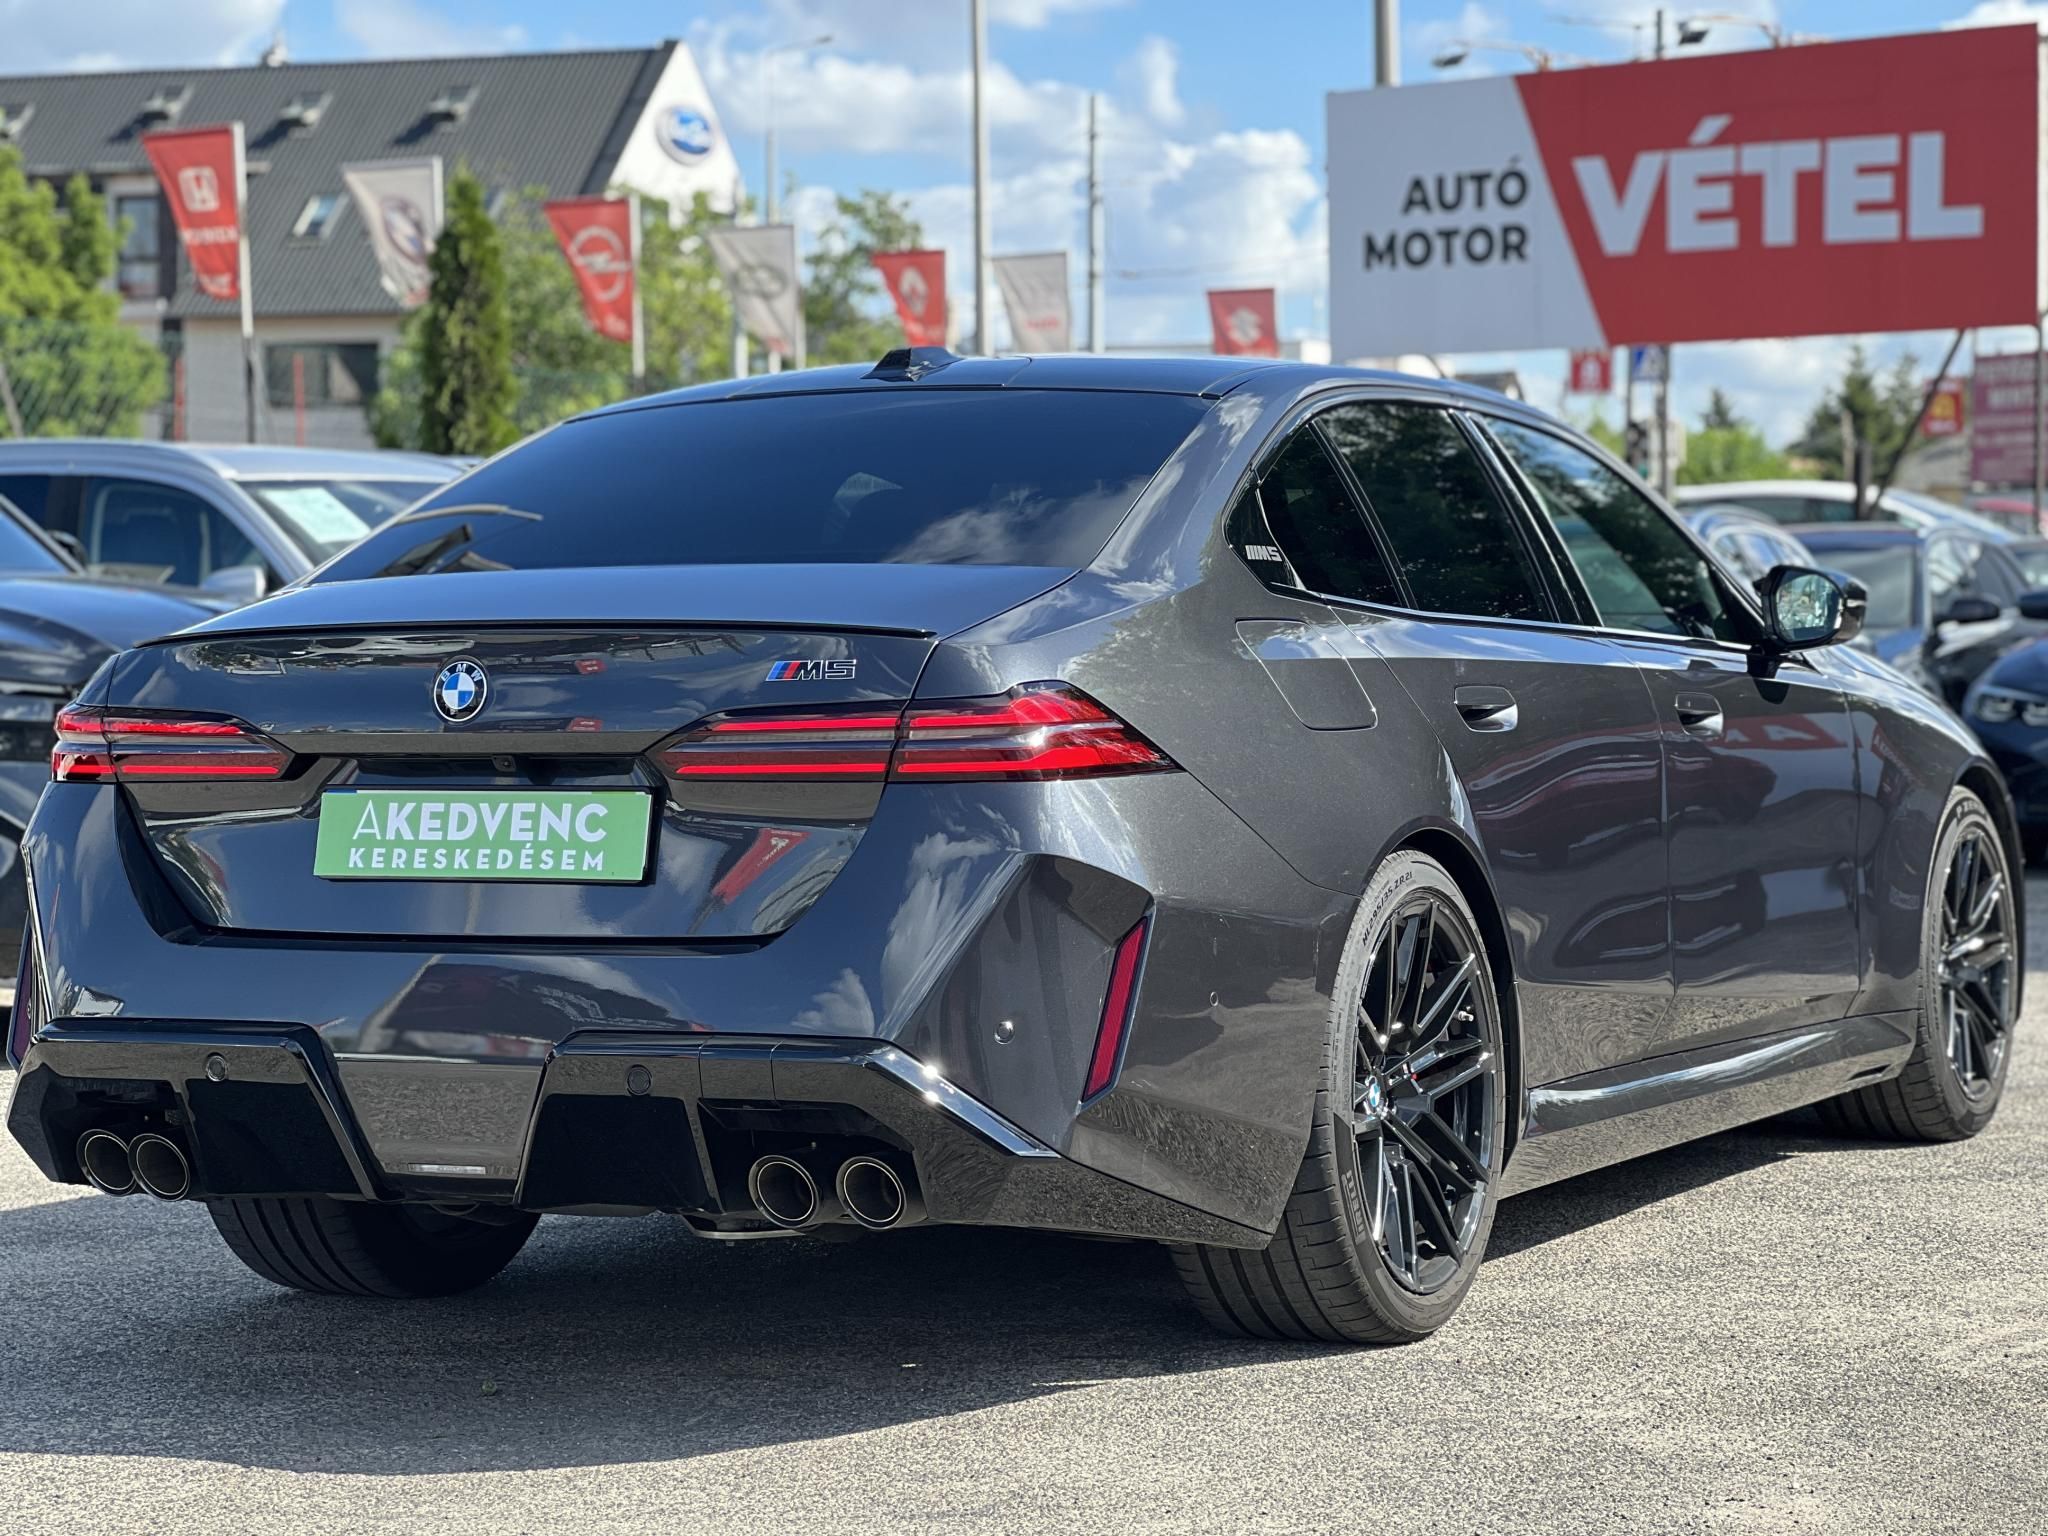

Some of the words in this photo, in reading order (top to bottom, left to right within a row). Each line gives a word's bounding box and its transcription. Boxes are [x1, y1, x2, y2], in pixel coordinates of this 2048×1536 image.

[1402, 156, 1528, 215] AUTÓ
[1571, 114, 1985, 257] VÉTEL
[1363, 223, 1528, 270] MOTOR
[440, 663, 482, 682] BMW
[348, 843, 604, 871] KERESKEDÉSEM
[1341, 1170, 1366, 1246] PIRELLI
